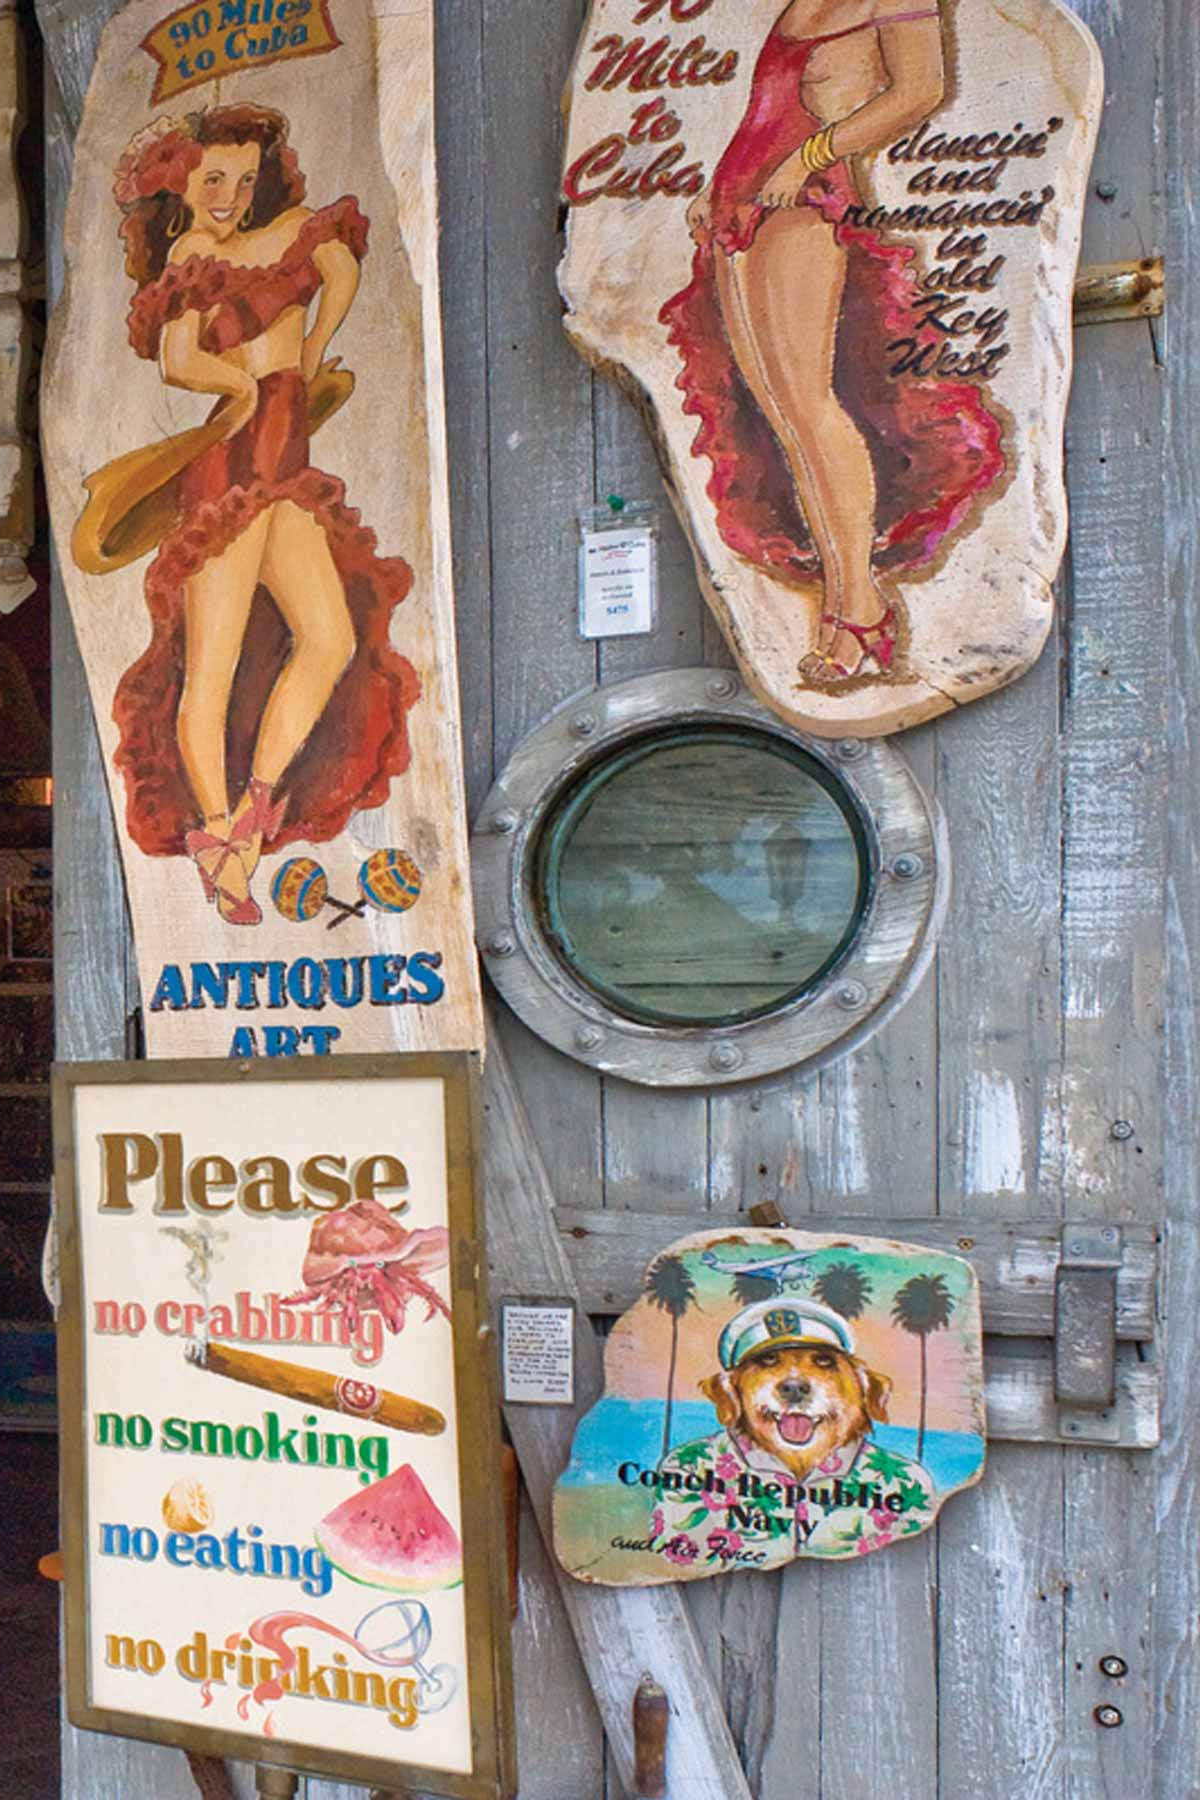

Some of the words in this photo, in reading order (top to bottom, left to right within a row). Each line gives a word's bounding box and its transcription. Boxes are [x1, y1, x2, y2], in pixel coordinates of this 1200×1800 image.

[169, 9, 211, 48] 90
[176, 49, 216, 79] to
[223, 24, 309, 59] Cuba
[584, 35, 739, 93] Miles
[627, 96, 683, 145] to
[887, 116, 1064, 164] dancin'
[563, 133, 705, 207] Cuba
[906, 159, 1009, 195] and
[933, 228, 988, 259] in
[922, 254, 1008, 293] old
[911, 293, 1009, 349] Key
[886, 337, 1010, 380] West
[149, 951, 446, 1012] ANTIQUES
[227, 1025, 342, 1057] ART
[97, 1132, 410, 1220] Please
[93, 1299, 147, 1336] no
[156, 1292, 385, 1368] crabbing
[95, 1411, 154, 1449] no
[161, 1411, 390, 1484] smoking
[617, 1461, 727, 1494] Conch
[611, 1535, 657, 1553] and
[726, 1503, 819, 1544] Navy
[99, 1521, 159, 1561] no
[164, 1526, 334, 1597] eating
[105, 1632, 166, 1675] no
[175, 1631, 420, 1731] drinking
